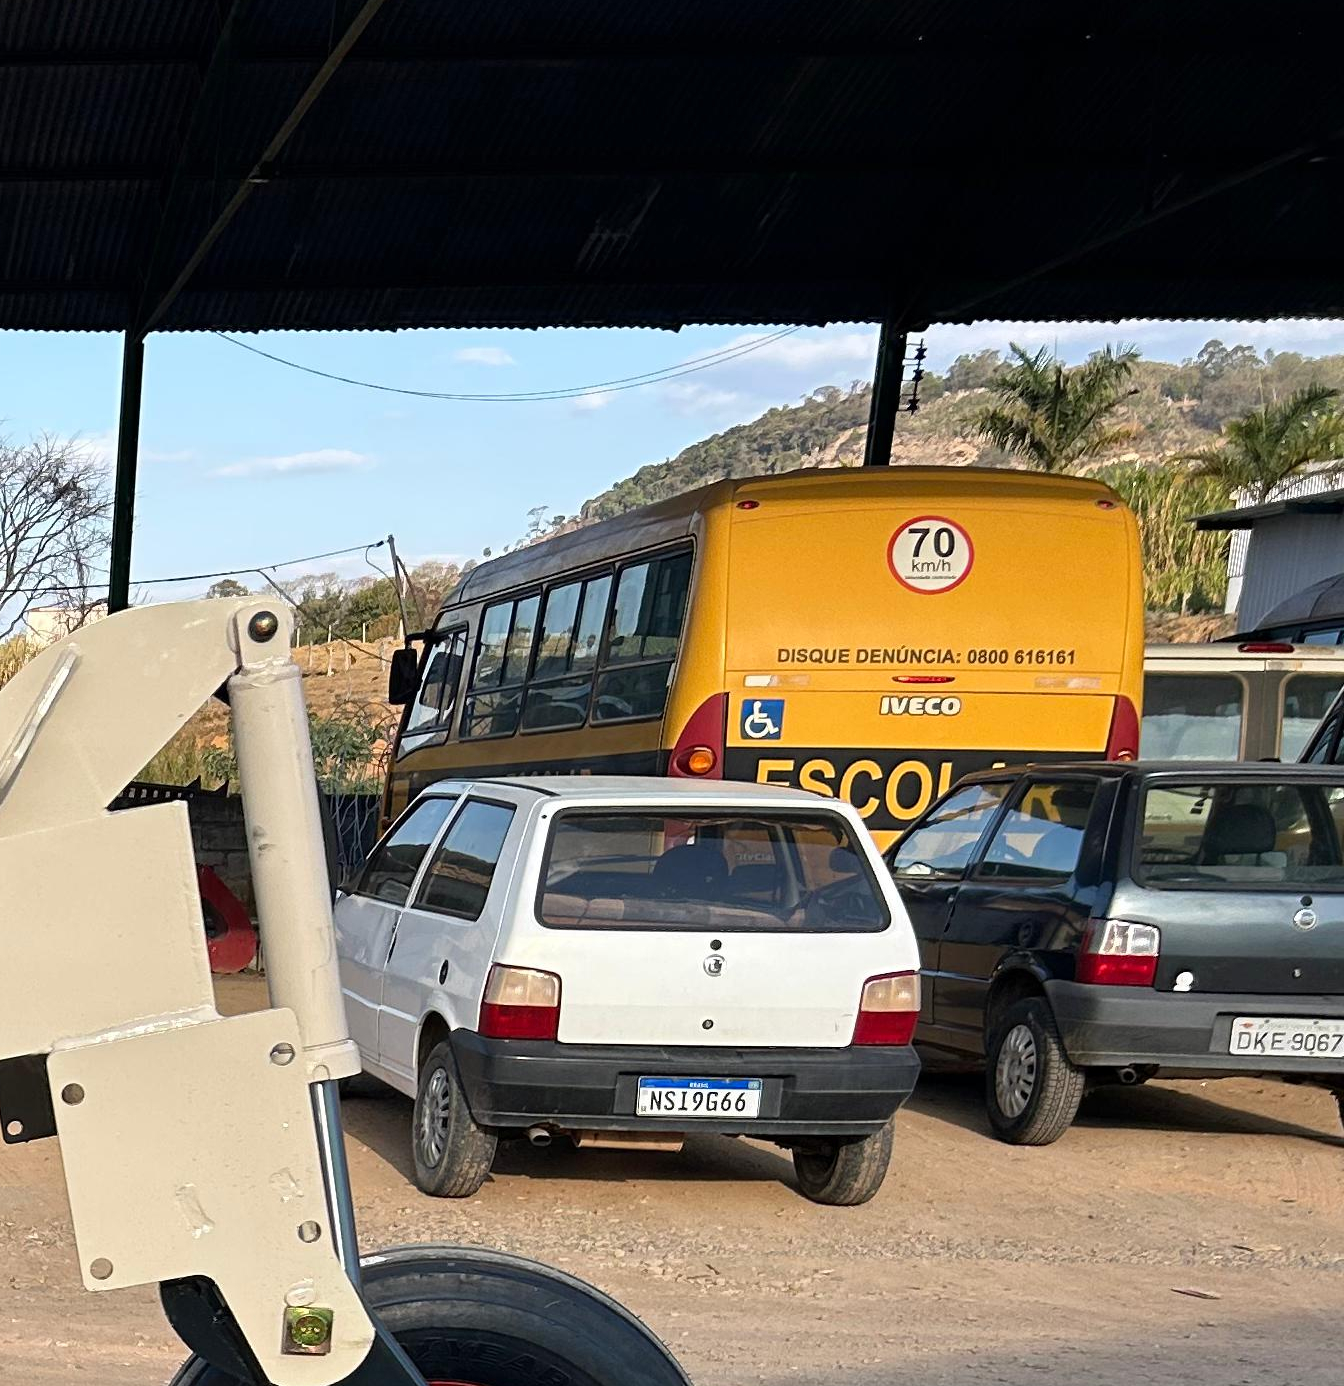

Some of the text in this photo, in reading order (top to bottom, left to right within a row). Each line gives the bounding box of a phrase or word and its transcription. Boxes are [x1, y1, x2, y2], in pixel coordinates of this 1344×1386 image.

[908, 527, 955, 558] 70
[911, 559, 951, 573] km/h
[777, 644, 1076, 666] DISQUE DENÚNCIA: 0800 616161
[879, 696, 962, 716] IVECO
[649, 1090, 746, 1112] NSI9G66
